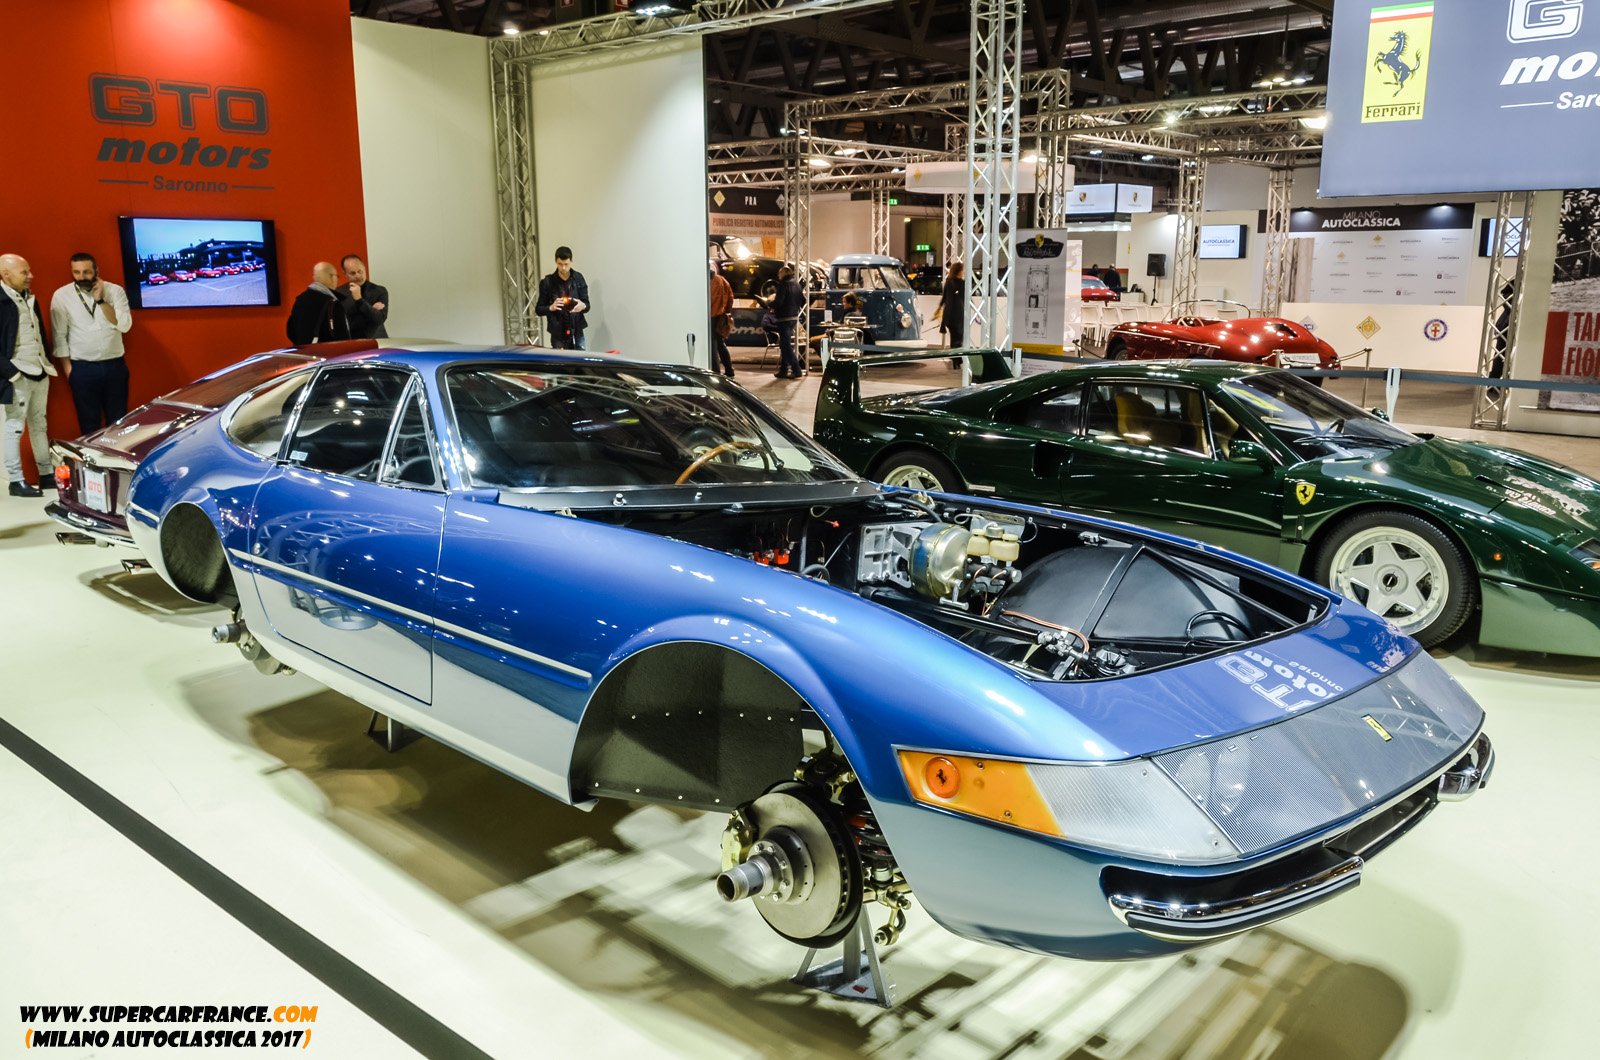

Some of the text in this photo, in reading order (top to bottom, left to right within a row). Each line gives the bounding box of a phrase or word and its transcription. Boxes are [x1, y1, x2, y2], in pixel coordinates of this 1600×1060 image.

[1500, 51, 1600, 86] mo
[88, 72, 270, 136] GTO
[1364, 102, 1421, 119] Ferrari
[97, 137, 272, 170] motors
[153, 175, 229, 193] Saronno
[744, 195, 757, 206] PRA
[1321, 217, 1401, 229] AUTOCLASSICA
[1342, 210, 1381, 220] MILANO
